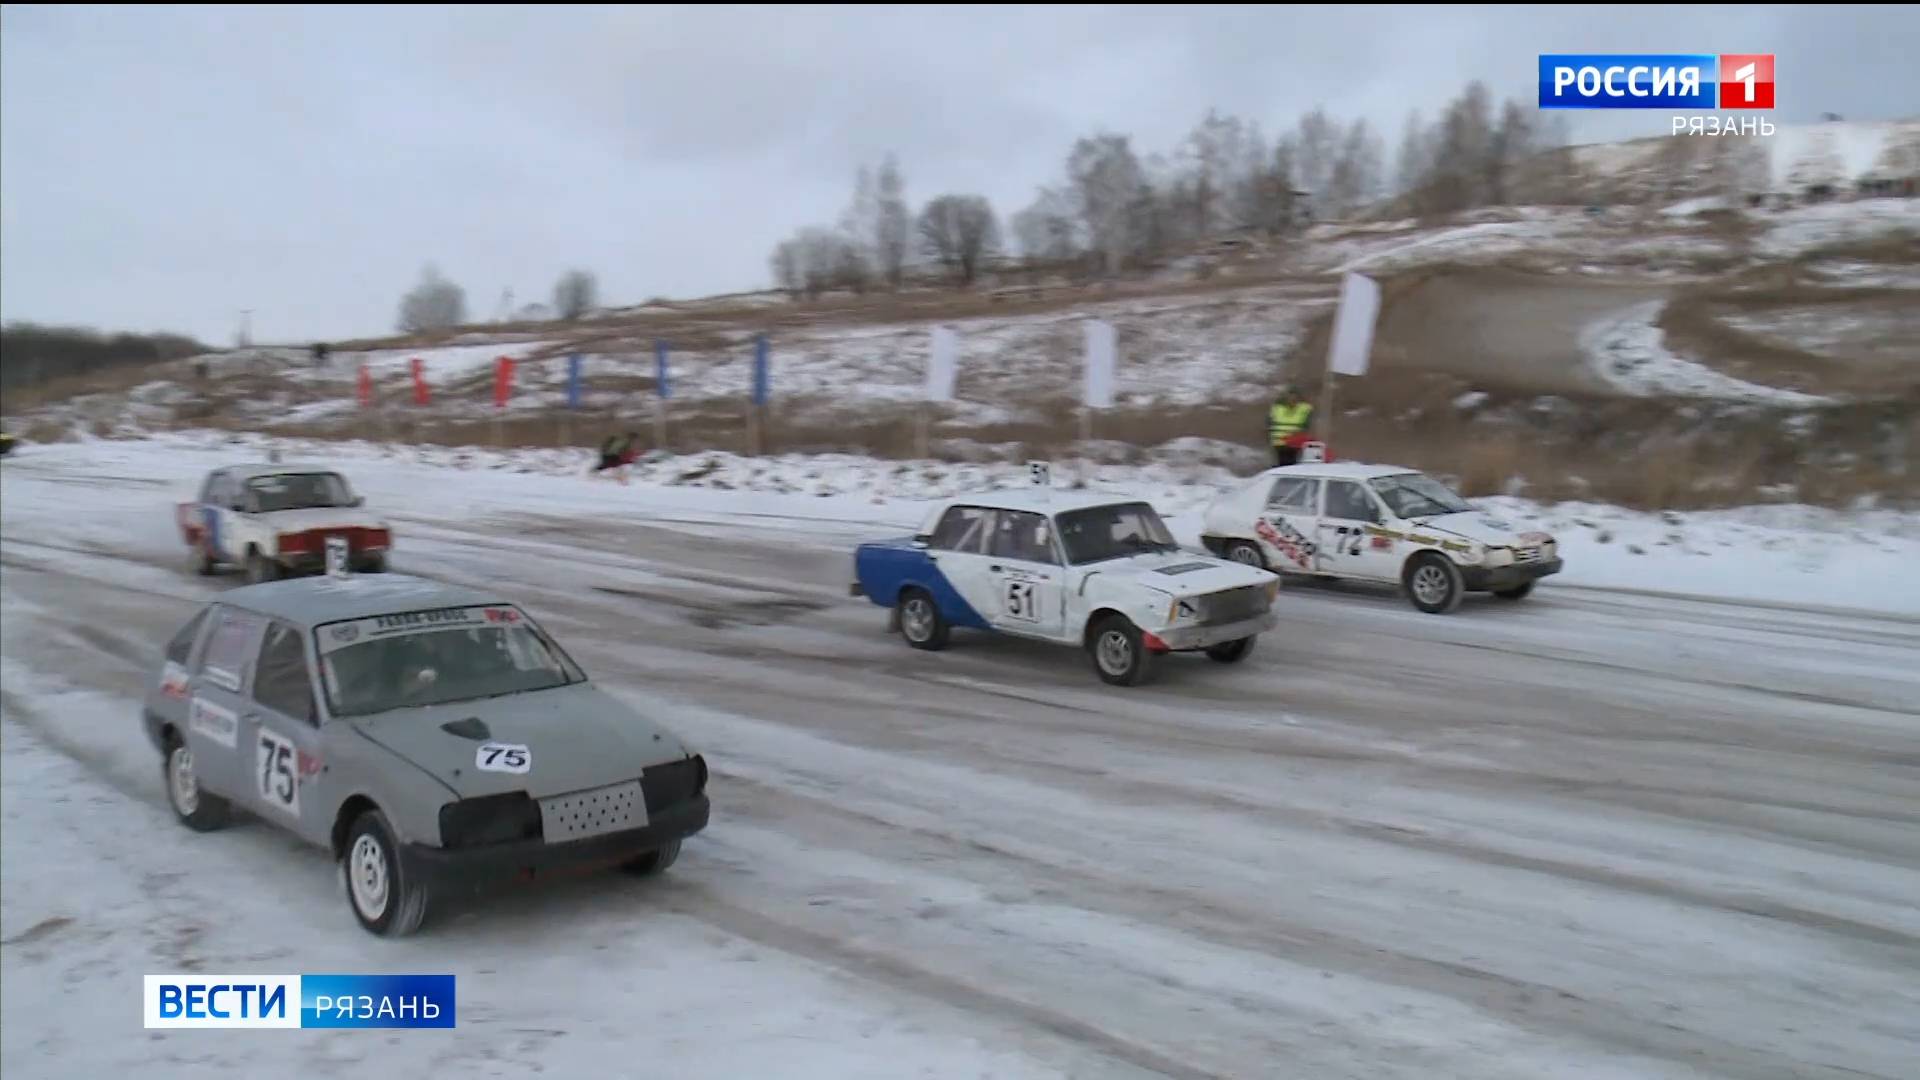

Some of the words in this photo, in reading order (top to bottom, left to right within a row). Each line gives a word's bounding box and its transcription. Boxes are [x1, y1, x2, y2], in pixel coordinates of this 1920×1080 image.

[1337, 526, 1364, 556] 72
[1008, 583, 1034, 618] 51
[262, 737, 294, 804] 75
[482, 746, 527, 768] 75
